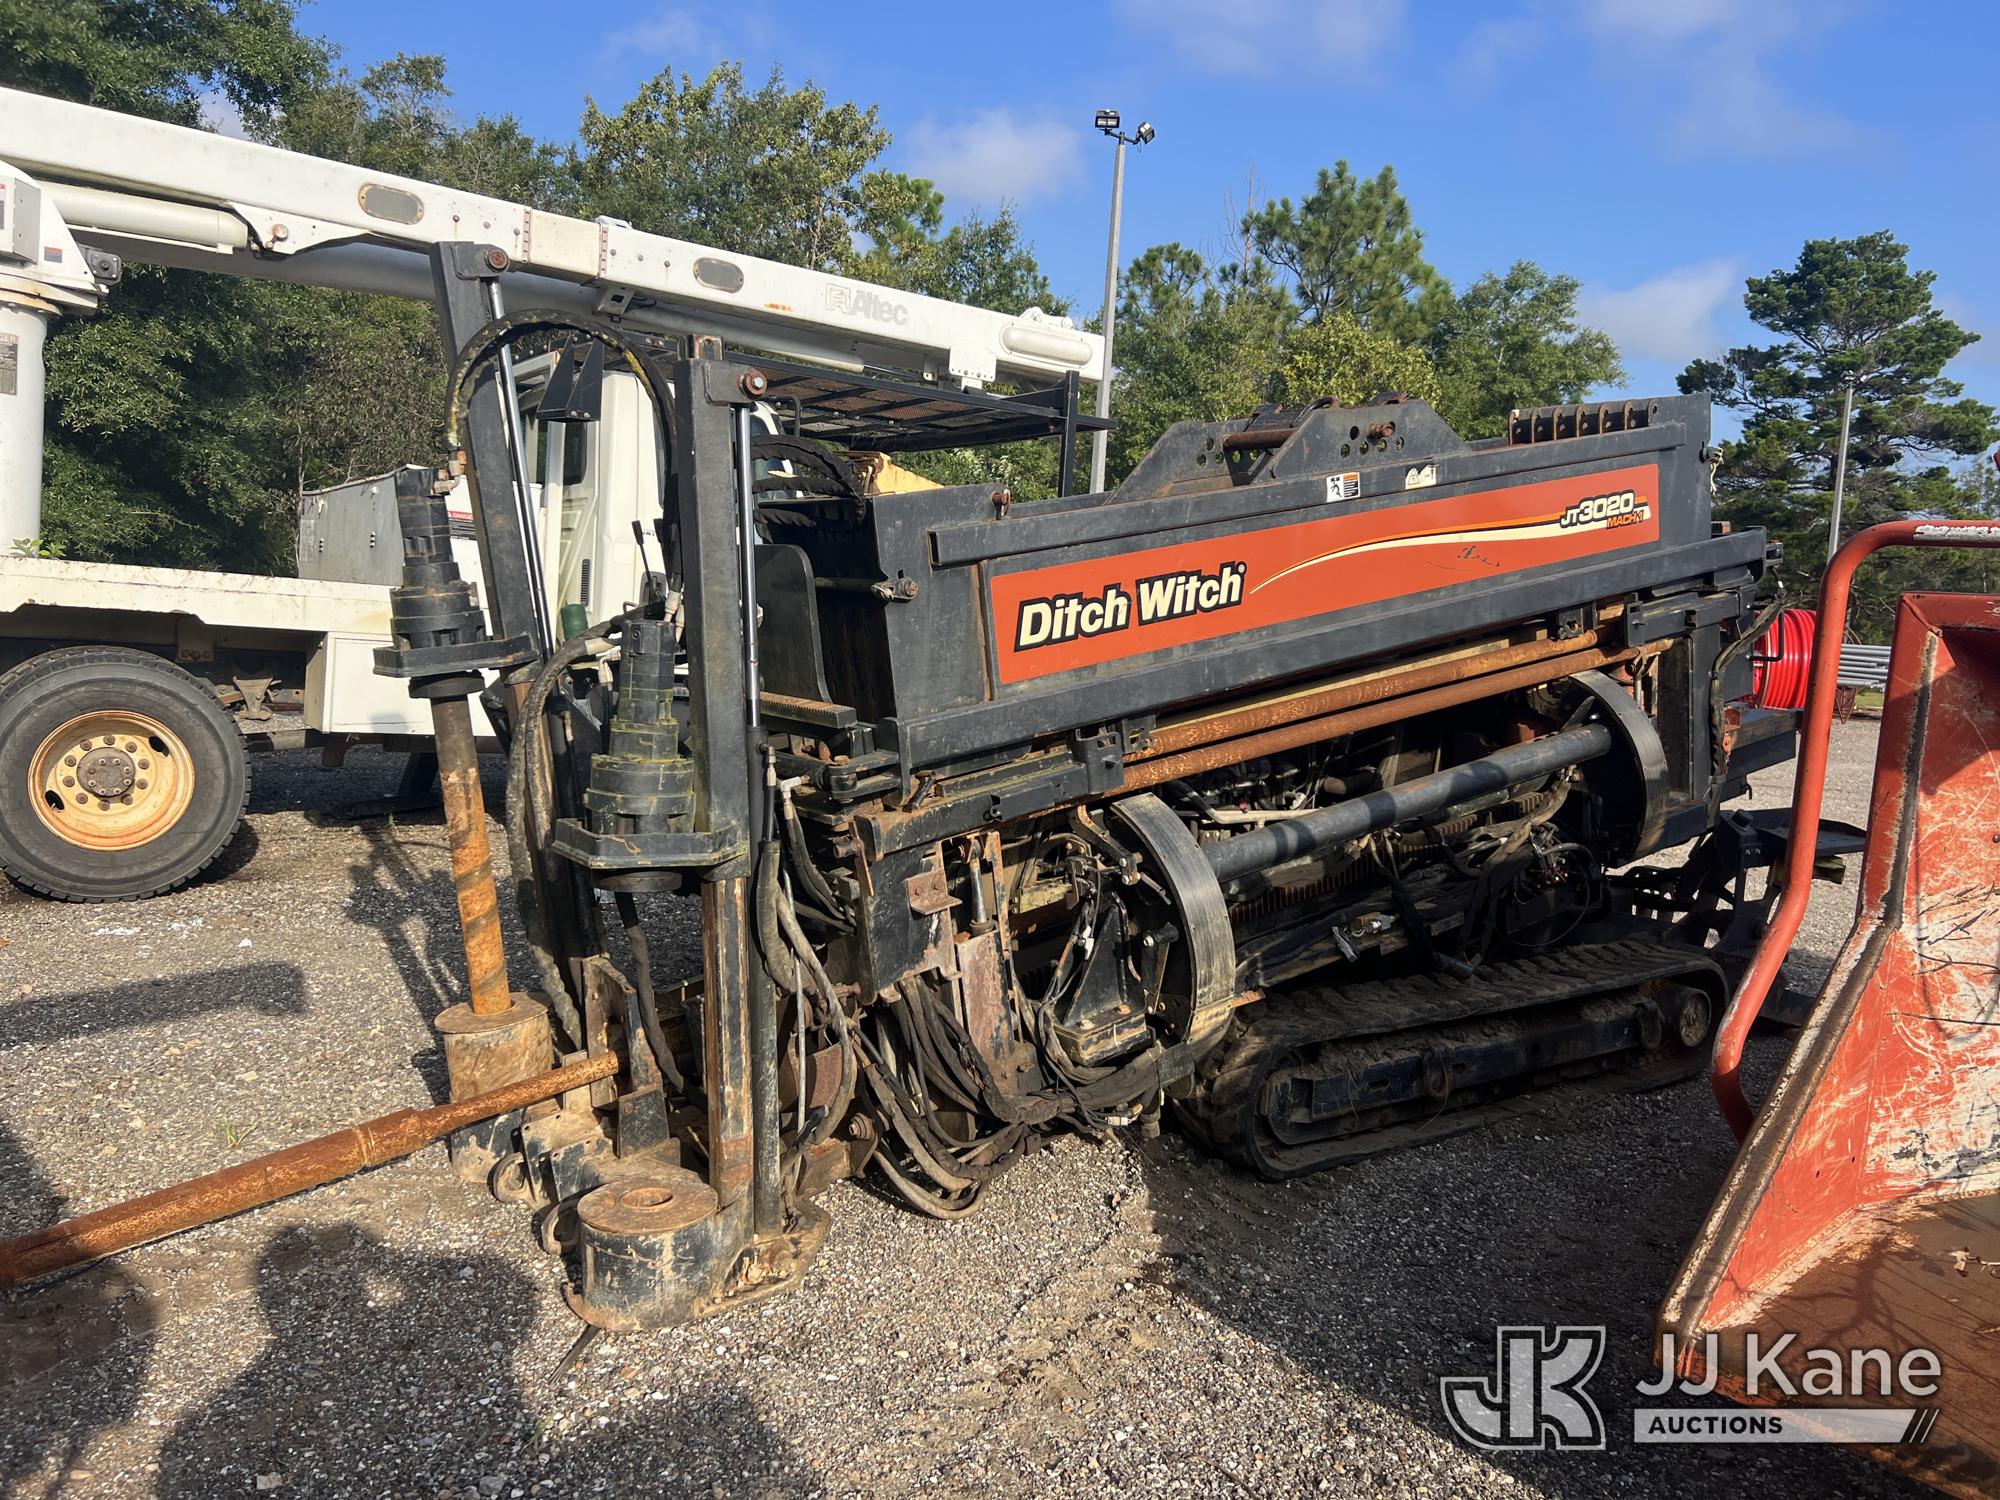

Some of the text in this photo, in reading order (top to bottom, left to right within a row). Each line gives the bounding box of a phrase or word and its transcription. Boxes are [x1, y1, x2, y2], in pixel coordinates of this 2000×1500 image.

[851, 289, 908, 326] Altec
[1560, 491, 1635, 526] JT3020
[1606, 512, 1637, 528] MACH
[1018, 566, 1242, 647] Ditch Witch
